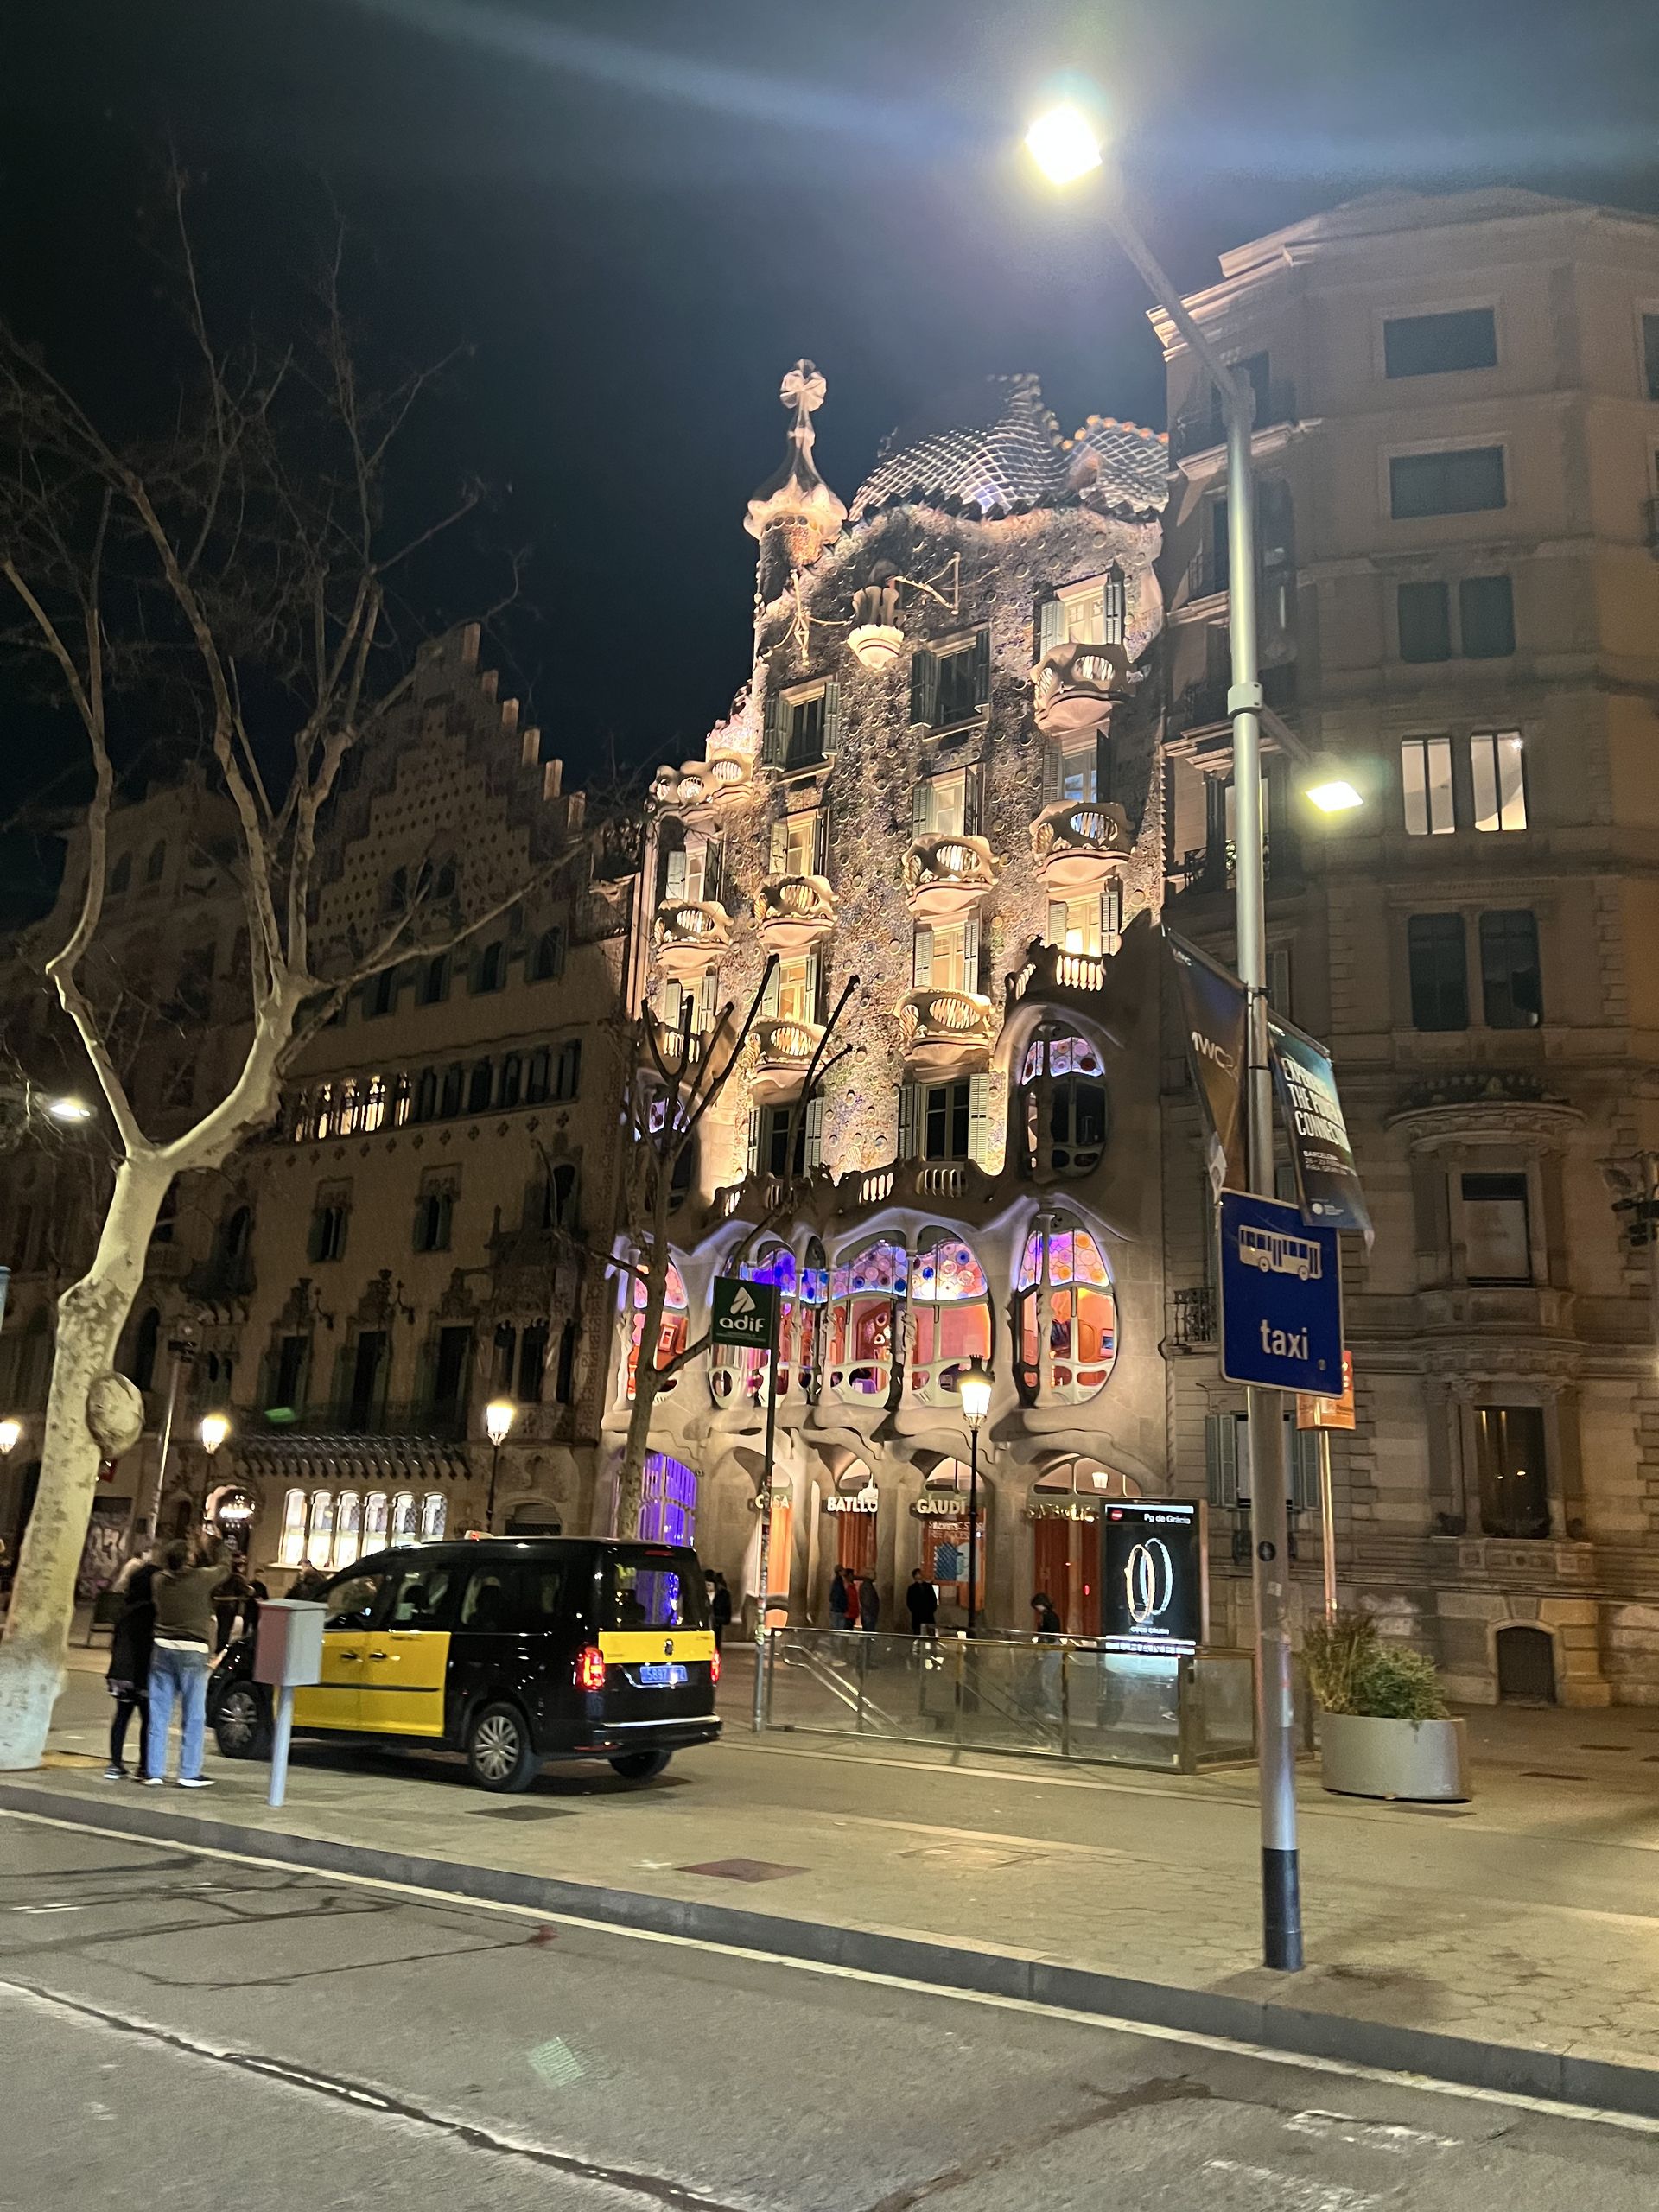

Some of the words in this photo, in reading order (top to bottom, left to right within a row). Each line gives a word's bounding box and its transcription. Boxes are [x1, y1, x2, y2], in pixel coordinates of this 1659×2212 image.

[1287, 1083, 1313, 1111] THE
[719, 1314, 766, 1332] adif
[1260, 1319, 1308, 1361] taxi
[754, 1493, 790, 1509] CSA
[1143, 1513, 1155, 1523] Pg
